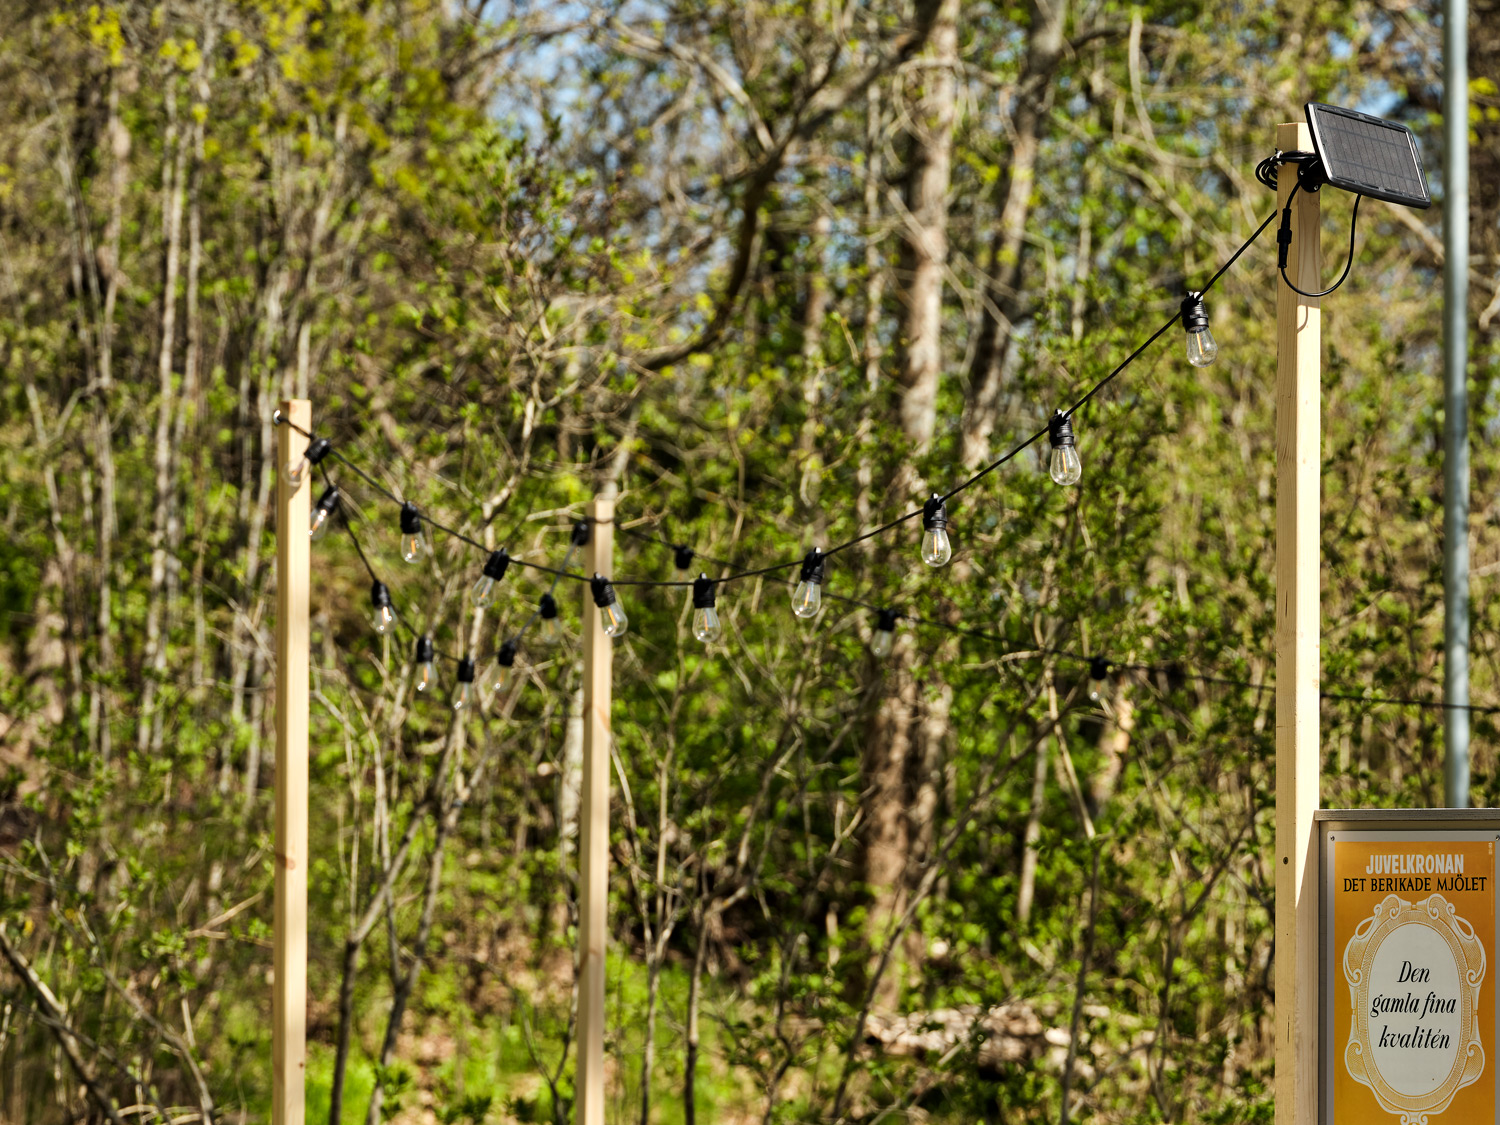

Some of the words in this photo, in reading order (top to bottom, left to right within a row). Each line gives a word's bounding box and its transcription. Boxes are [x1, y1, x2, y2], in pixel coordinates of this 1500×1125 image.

[1366, 854, 1464, 874] JUVELKRONAN
[1343, 878, 1366, 892] DET
[1371, 877, 1431, 891] BERIKADE
[1437, 874, 1487, 891] MJÖLET
[1397, 961, 1430, 983] Den
[1370, 992, 1420, 1018] gamla
[1419, 991, 1456, 1020] fina
[1379, 1025, 1450, 1049] kvalitén
